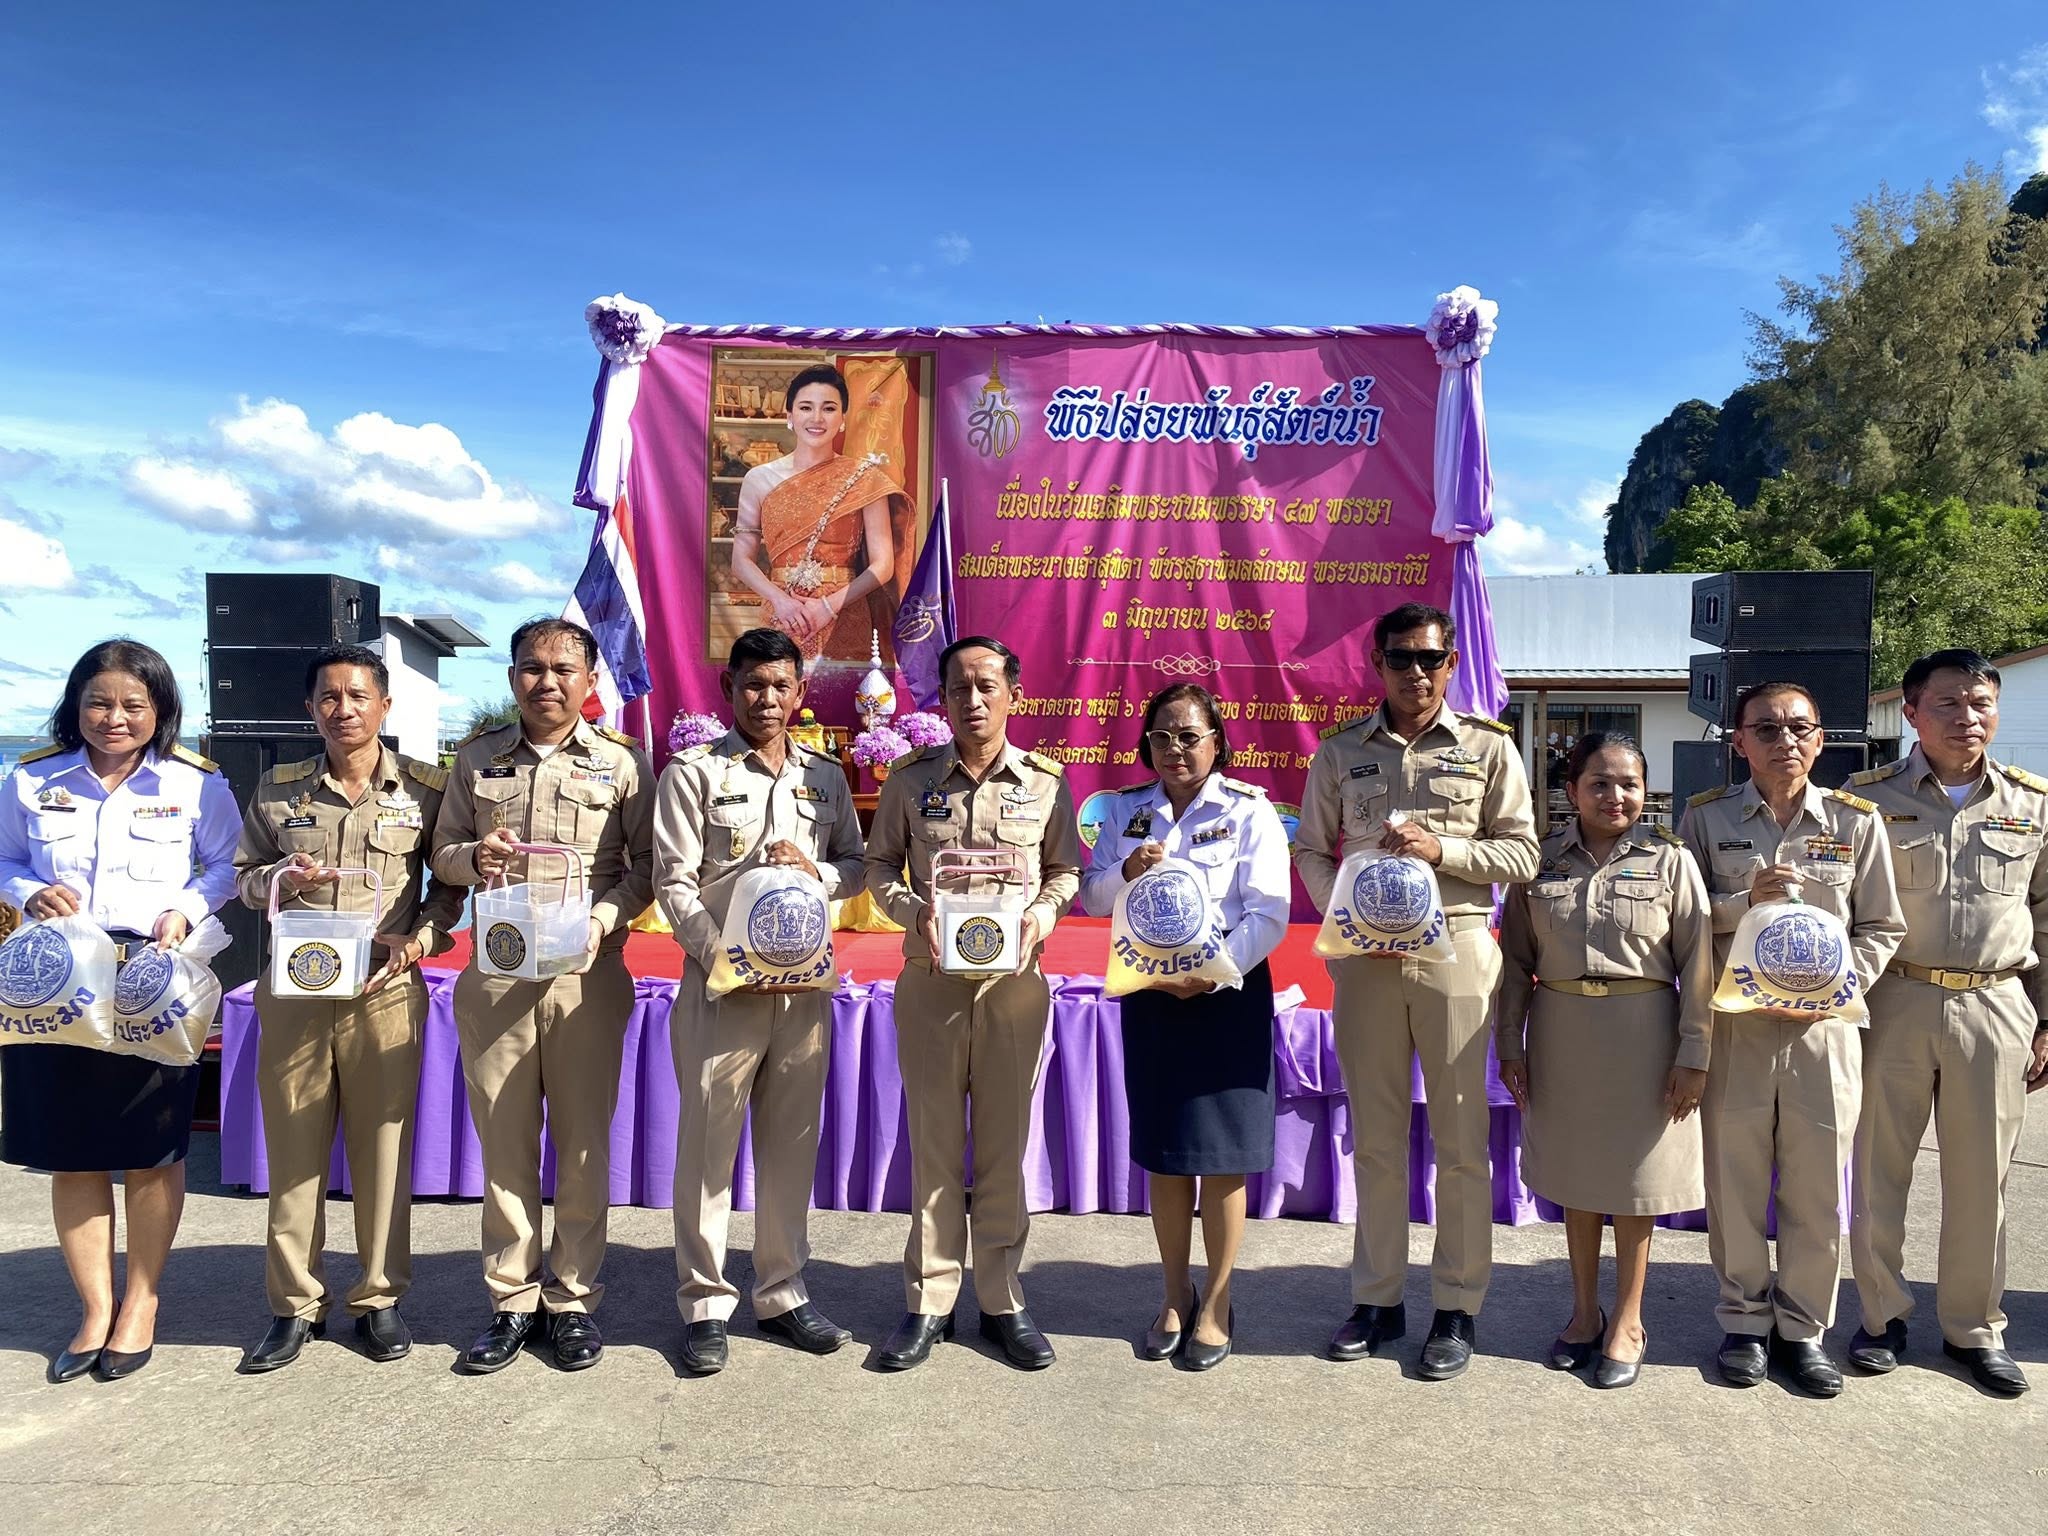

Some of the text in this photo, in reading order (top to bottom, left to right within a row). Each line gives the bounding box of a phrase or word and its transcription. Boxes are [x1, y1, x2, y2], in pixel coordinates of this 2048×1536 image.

[1045, 377, 1381, 460] พิธีปล่อยพันธุ์สัตว์น้ำ
[996, 473, 1392, 525] เนื่องในวันเฉลิมพระชนมพรรษา ๔๗ พรรษา
[957, 541, 1431, 591] สมเด็จพระนางเจ้าสุทิดา พัชรสุธาพิมลลักษณ พระบรมราชินี
[1102, 597, 1275, 639] ๓ มิถุนายน ๒๕๖๘
[1087, 685, 1122, 725] หมู่ที่
[1245, 694, 1329, 722] อำเภอกันตัง
[1112, 748, 1140, 765] ๑๗
[1114, 923, 1223, 976] กรมประมง
[1334, 907, 1444, 951] กรมประมง
[727, 941, 834, 988] กรมประมง
[1732, 964, 1858, 1011] กรมประมง
[114, 999, 190, 1043] ประมง
